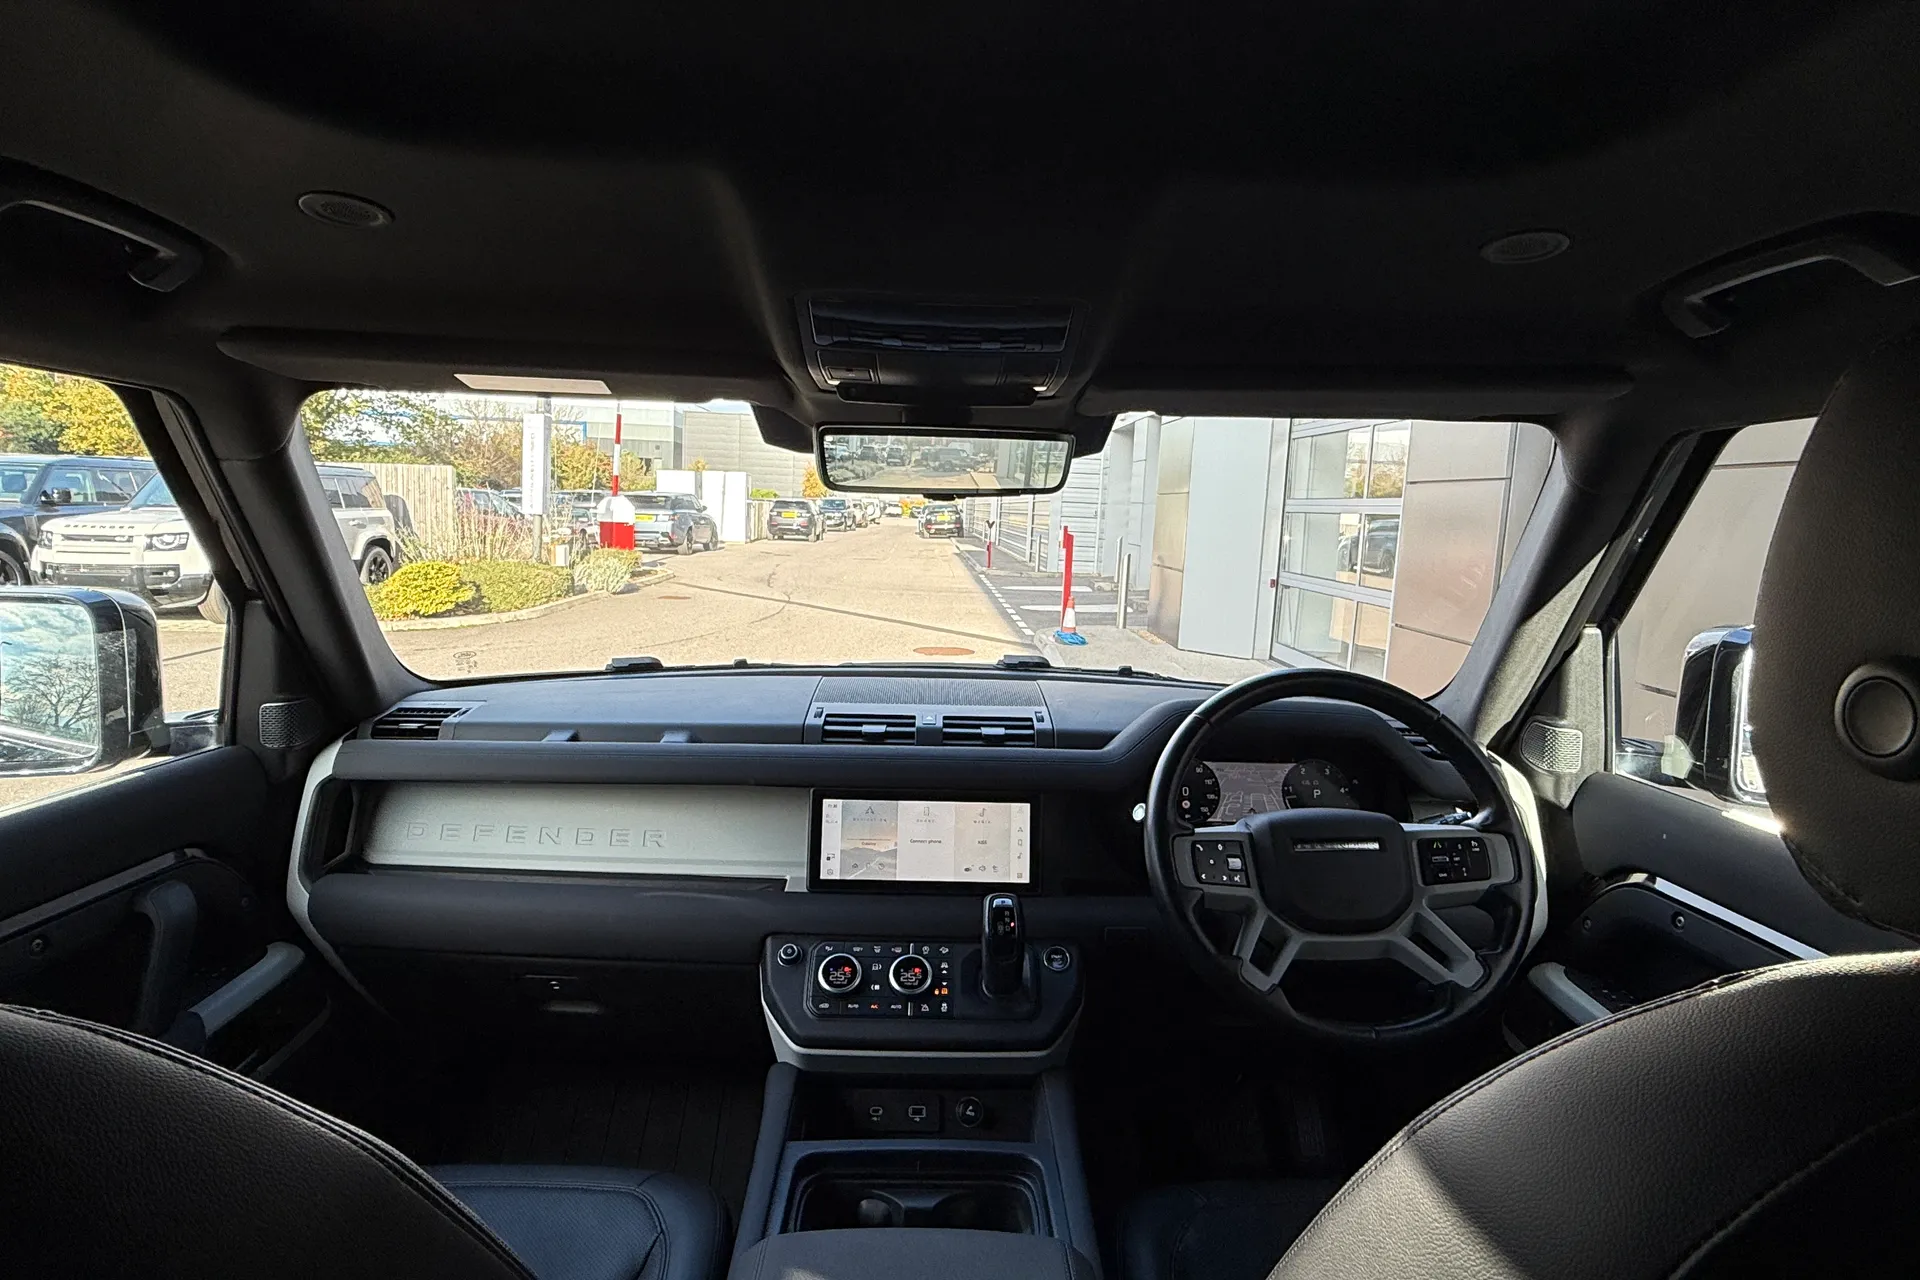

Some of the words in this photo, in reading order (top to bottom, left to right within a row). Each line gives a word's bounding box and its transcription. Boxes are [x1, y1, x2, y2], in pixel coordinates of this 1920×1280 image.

[1299, 767, 1306, 775] 2
[1323, 767, 1331, 775] 3
[1312, 788, 1321, 799] P
[405, 821, 668, 848] DEFENDER
